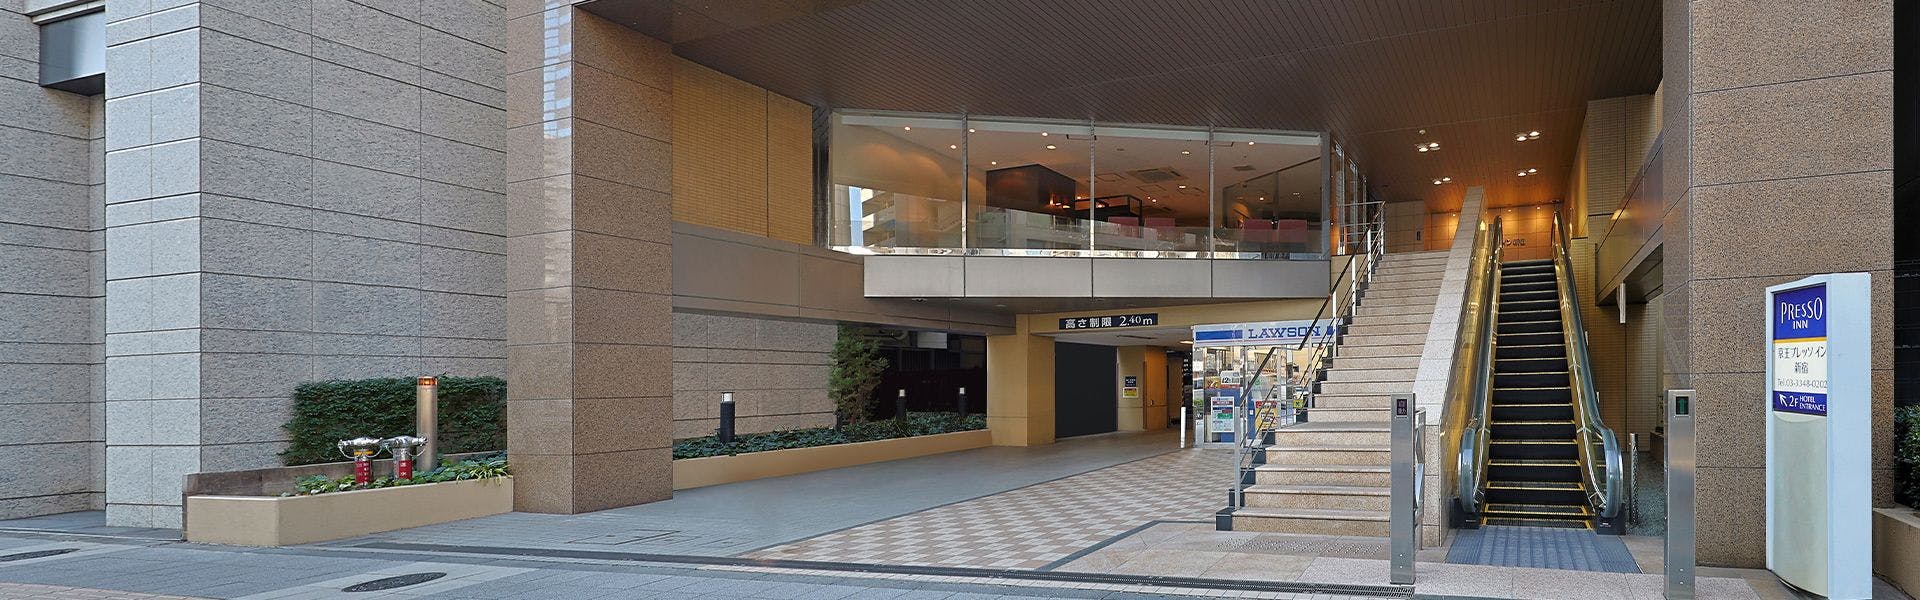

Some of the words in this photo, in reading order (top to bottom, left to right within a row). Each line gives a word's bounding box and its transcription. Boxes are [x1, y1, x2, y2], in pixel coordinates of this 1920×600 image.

[1781, 297, 1823, 324] PRESSO
[1065, 317, 1112, 329] 高さ制限
[1793, 320, 1808, 329] INN
[1248, 326, 1321, 339] LAWSON
[1794, 361, 1809, 374] 新宿
[1789, 396, 1798, 407] 2F
[1799, 395, 1816, 403] HOTEL
[1799, 402, 1826, 412] ENTRANCE
